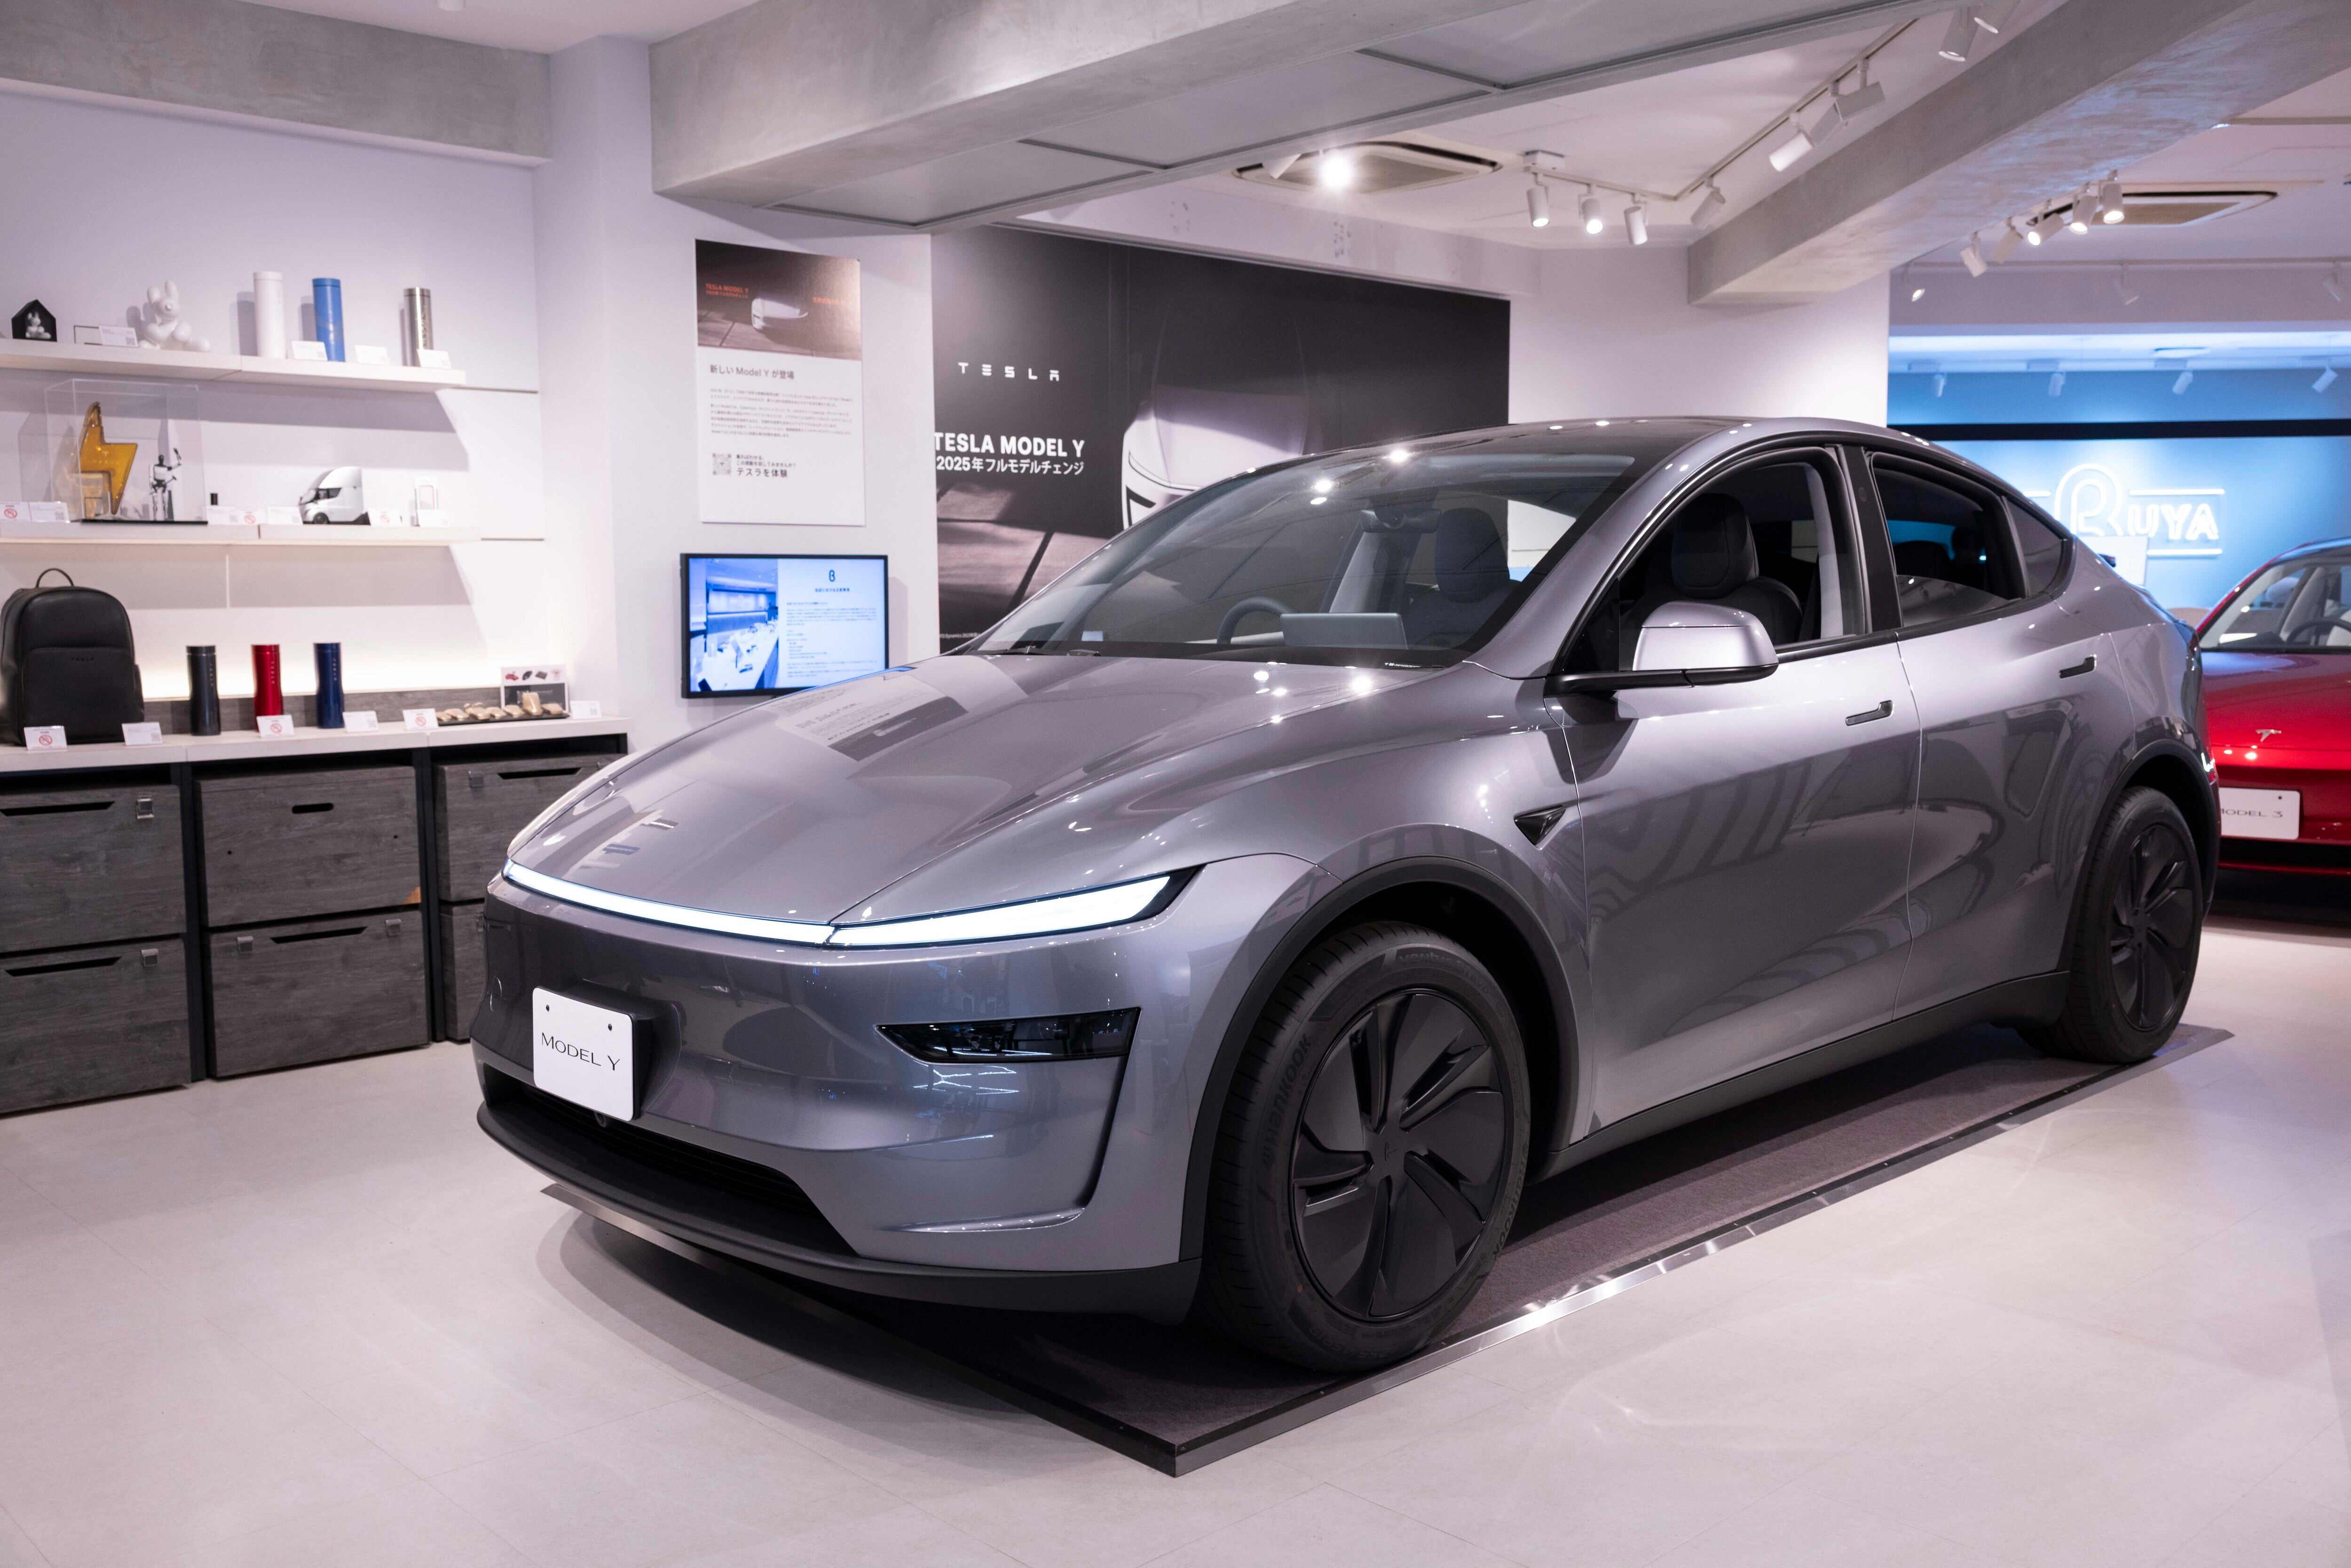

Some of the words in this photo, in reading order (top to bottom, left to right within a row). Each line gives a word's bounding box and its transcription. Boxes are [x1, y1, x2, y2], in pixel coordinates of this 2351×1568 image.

[710, 364, 734, 374] 新しい
[736, 367, 761, 376] Model
[772, 370, 794, 380] が登場
[957, 362, 1060, 382] TESLA
[934, 432, 995, 454] TESLA
[1000, 435, 1067, 457] MODEL
[1072, 440, 1085, 457] Y
[737, 468, 788, 478] テスラを体験
[936, 456, 1084, 476] 2025年フルモデルチェンジ
[2054, 463, 2219, 540] RUYA
[542, 1032, 601, 1066] MODEL
[607, 1055, 621, 1072] Y
